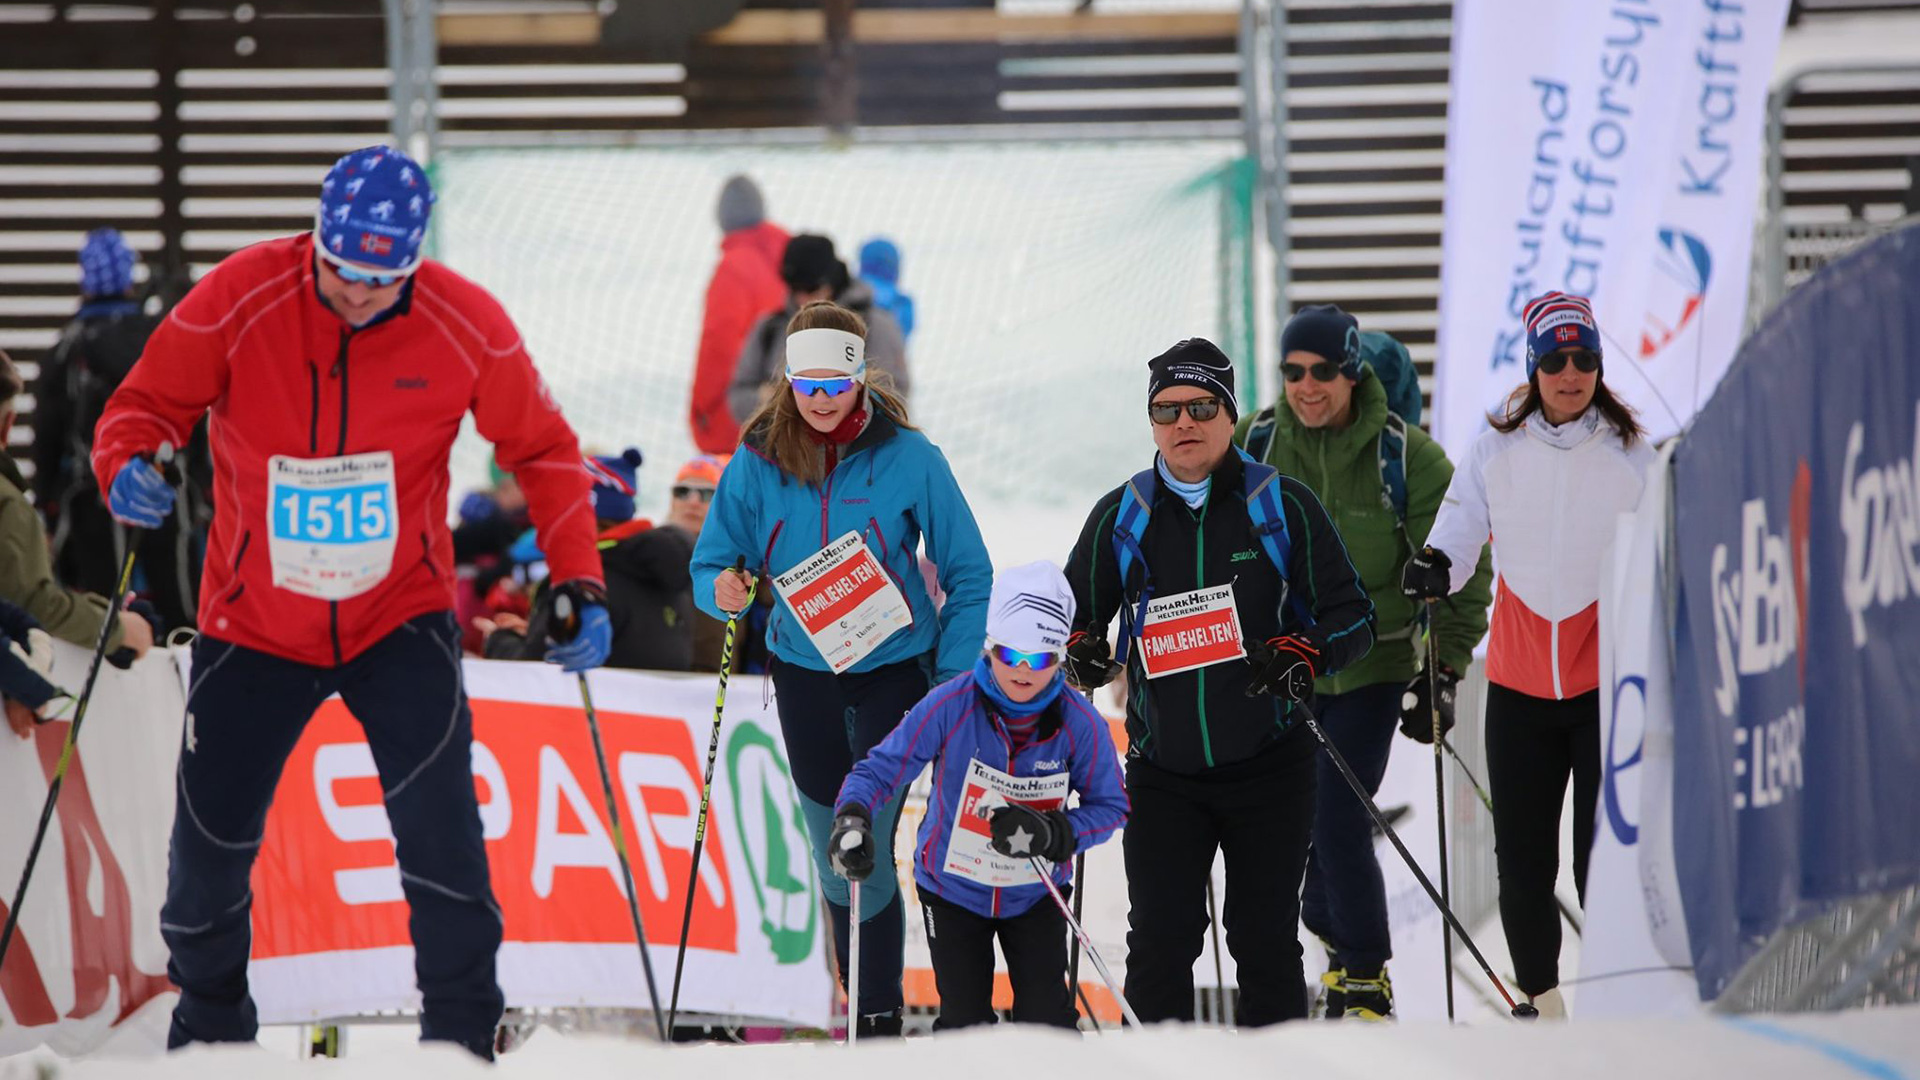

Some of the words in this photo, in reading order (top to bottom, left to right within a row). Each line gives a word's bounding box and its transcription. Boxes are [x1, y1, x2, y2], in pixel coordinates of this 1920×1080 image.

[1561, 0, 1661, 299] aftforsy
[1174, 372, 1208, 383] TRIMTEX
[281, 490, 387, 540] 1515
[776, 536, 858, 588] TELEMARKHELTEN
[800, 555, 845, 585] HELTERENNET
[1143, 590, 1230, 615] LEMARKHELTEN
[1157, 604, 1210, 620] HELTERENNET
[974, 763, 1065, 791] TELEMARKHELTEN
[991, 784, 1044, 798] HELTERENNET
